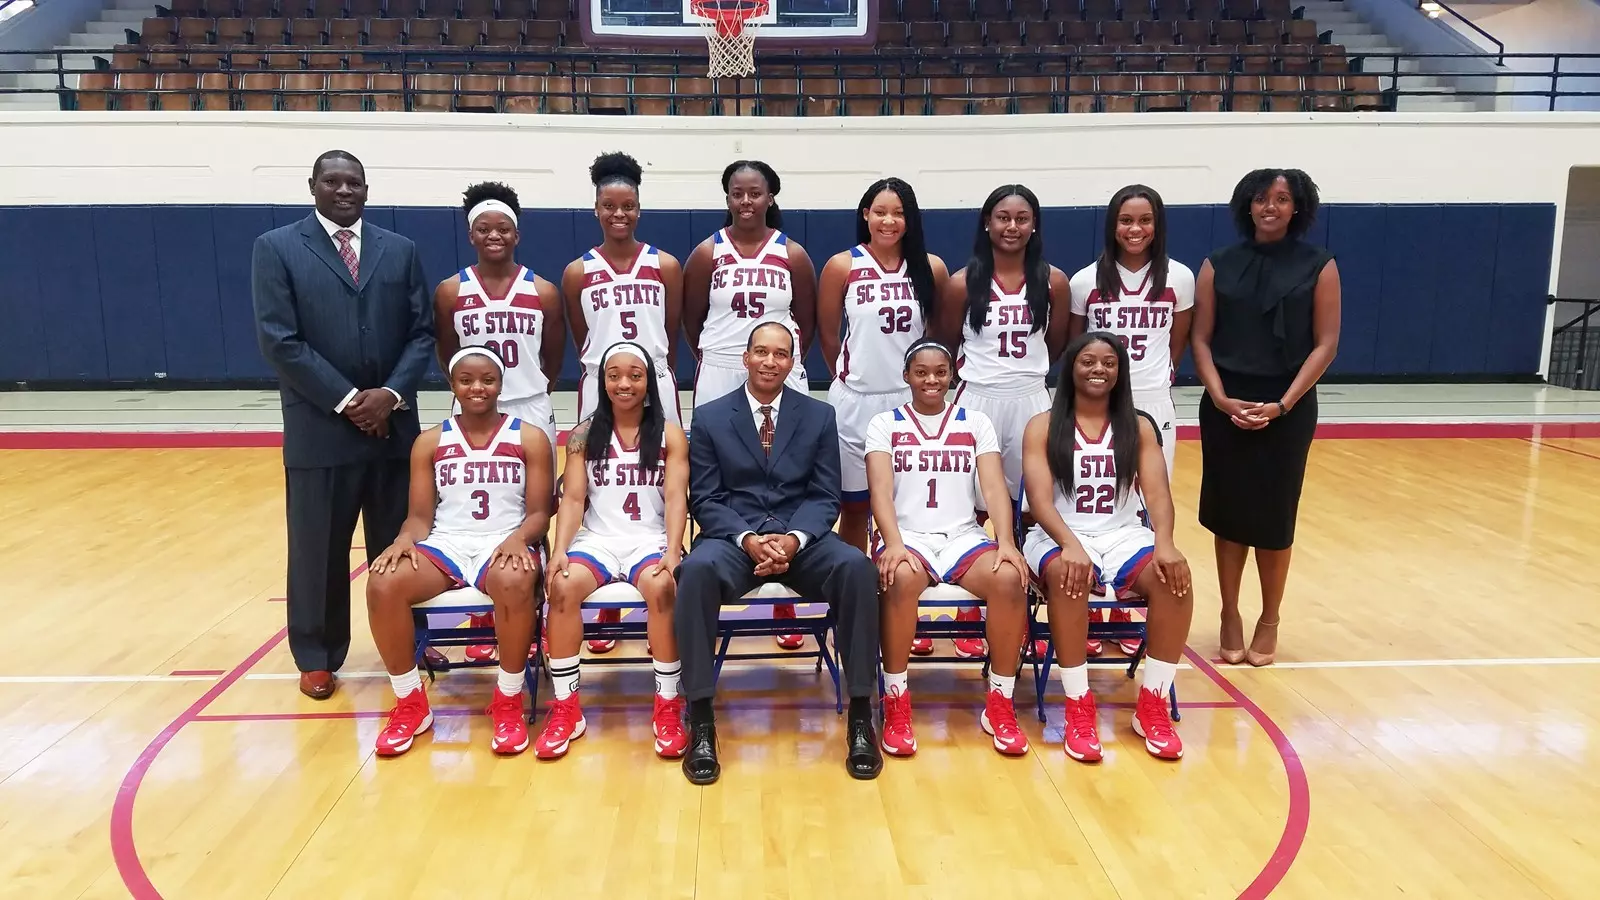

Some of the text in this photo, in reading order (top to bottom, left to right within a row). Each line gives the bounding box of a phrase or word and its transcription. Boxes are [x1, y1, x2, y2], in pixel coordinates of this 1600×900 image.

[713, 267, 787, 291] SC STATE
[590, 283, 660, 312] SC STATE
[731, 291, 767, 318] 45
[856, 282, 913, 305] SC STA
[462, 311, 536, 337] SC STATE
[620, 310, 638, 340] 5
[879, 305, 913, 334] 32
[983, 304, 1033, 327] C STA
[1094, 306, 1169, 329] SC STATE
[998, 331, 1029, 359] 15
[440, 461, 521, 487] SC STATE
[894, 450, 972, 473] SC STATE
[1080, 454, 1116, 478] STA
[592, 463, 610, 487] SC
[471, 489, 490, 520] 3
[622, 492, 642, 521] 4
[926, 478, 938, 509] 1
[1076, 484, 1115, 515] 22
